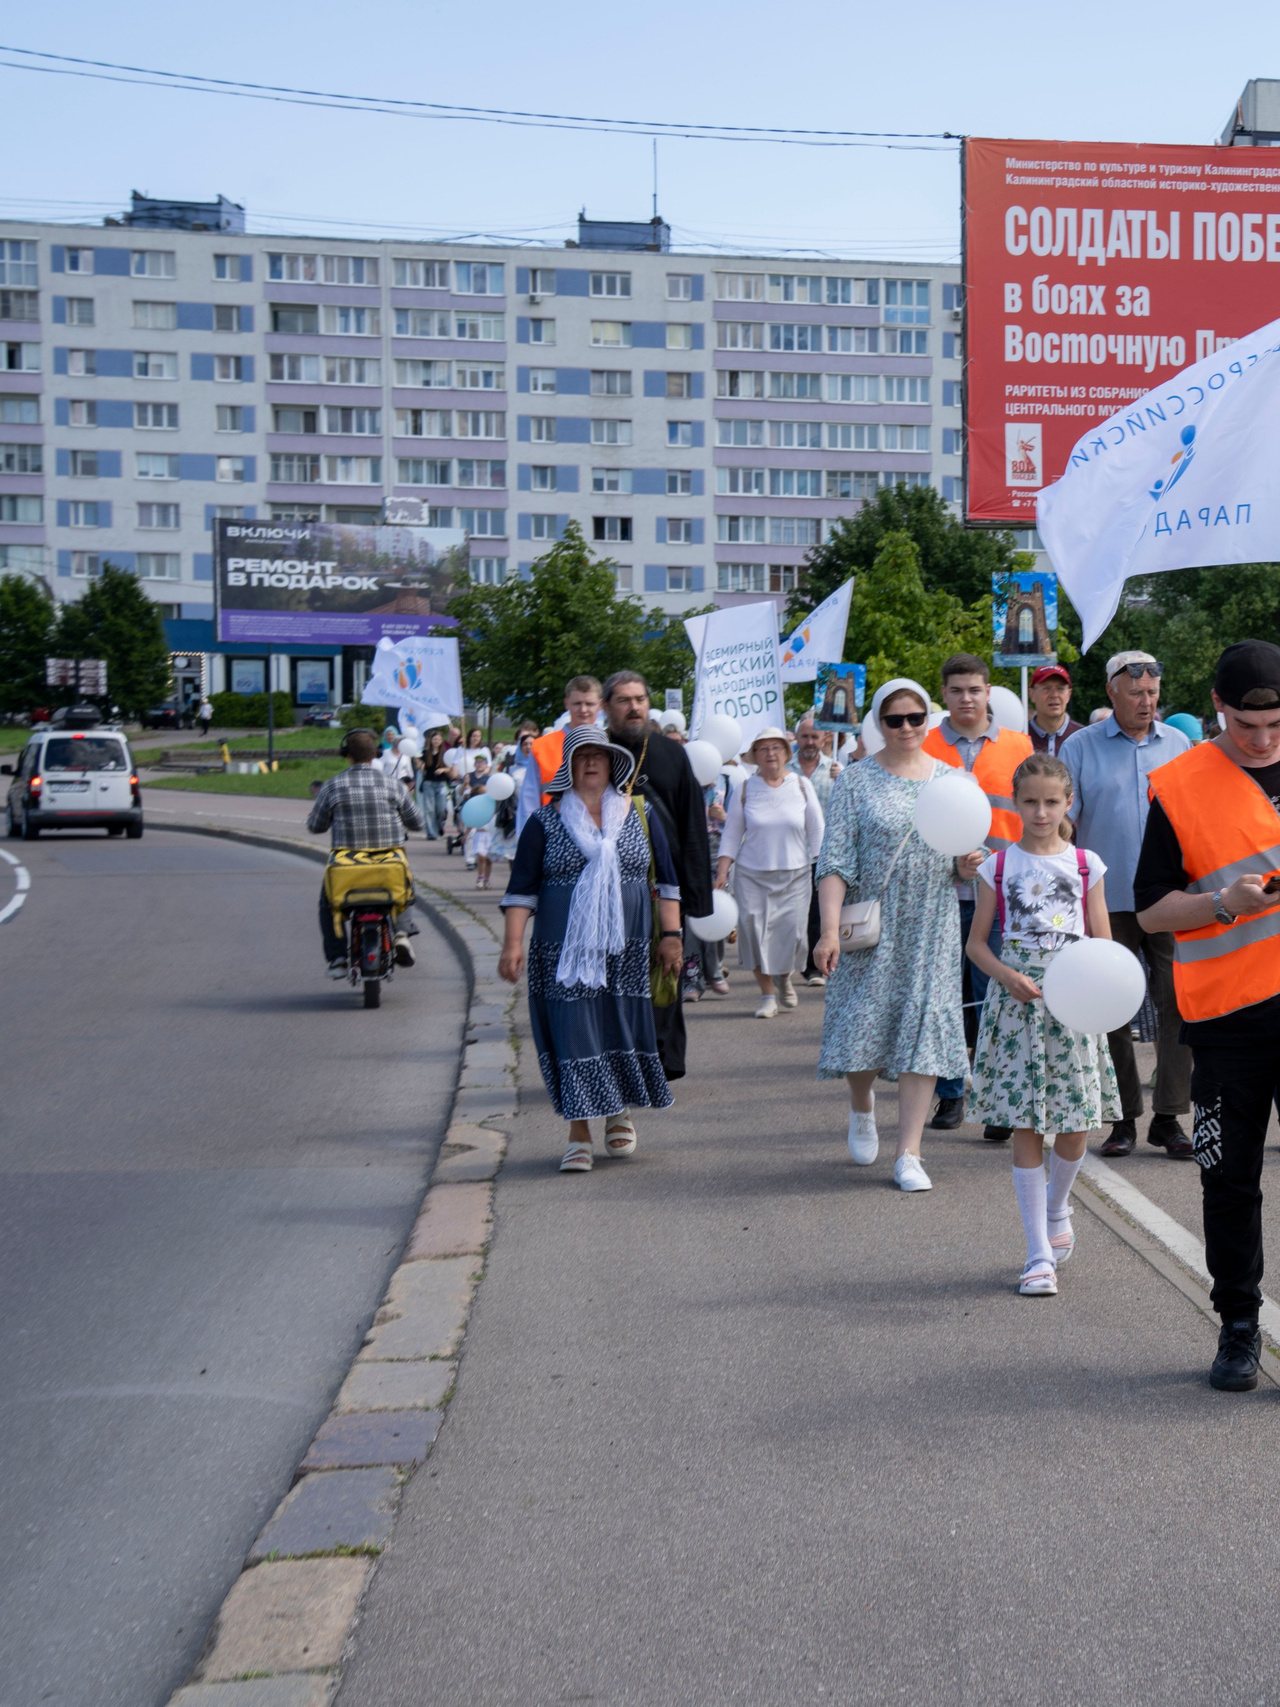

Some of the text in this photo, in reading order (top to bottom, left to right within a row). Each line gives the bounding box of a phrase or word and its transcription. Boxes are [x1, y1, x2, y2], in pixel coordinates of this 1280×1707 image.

[1005, 157, 1081, 171] Министерство
[1083, 162, 1097, 171] по
[1099, 162, 1147, 175] культуре
[1149, 164, 1156, 173] и
[1159, 164, 1203, 177] туризму
[1005, 173, 1099, 188] Калининградский
[1101, 177, 1157, 189] областной
[1004, 205, 1181, 266] СОЛДАТЫ
[1004, 274, 1151, 317] в боях за
[1004, 324, 1186, 374] Восточную
[1005, 384, 1067, 398] РАРИТЕТЫ
[1070, 386, 1087, 398] ИЗ
[1005, 403, 1096, 416] ЦЕНТРАЛЬНОГО
[226, 526, 311, 540] ВКЛЮЧИ
[227, 558, 338, 575] РЕМОНТ
[227, 572, 380, 591] В ПОДАРОК
[705, 637, 774, 662] ВСЕМИРНЫЙ
[709, 671, 776, 697] НАРОДНЫЙ
